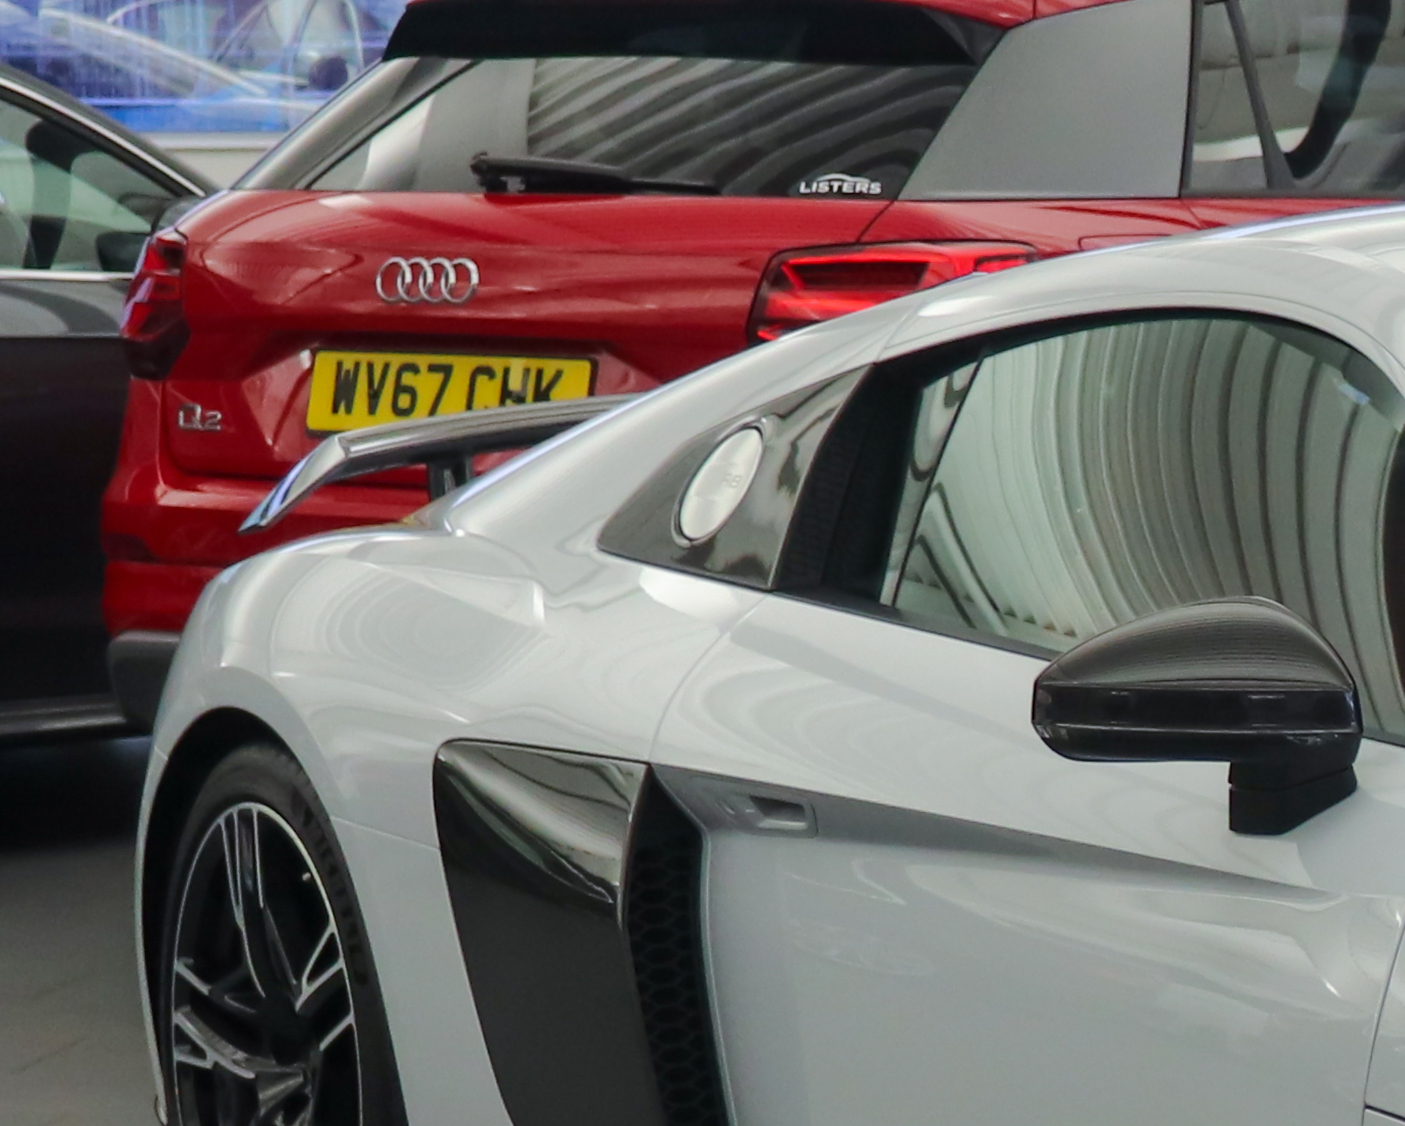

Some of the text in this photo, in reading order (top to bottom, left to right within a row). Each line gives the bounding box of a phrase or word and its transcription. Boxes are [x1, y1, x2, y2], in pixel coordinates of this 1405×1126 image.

[799, 181, 882, 194] LISTERS
[331, 360, 453, 417] WV67
[178, 403, 222, 431] Q2
